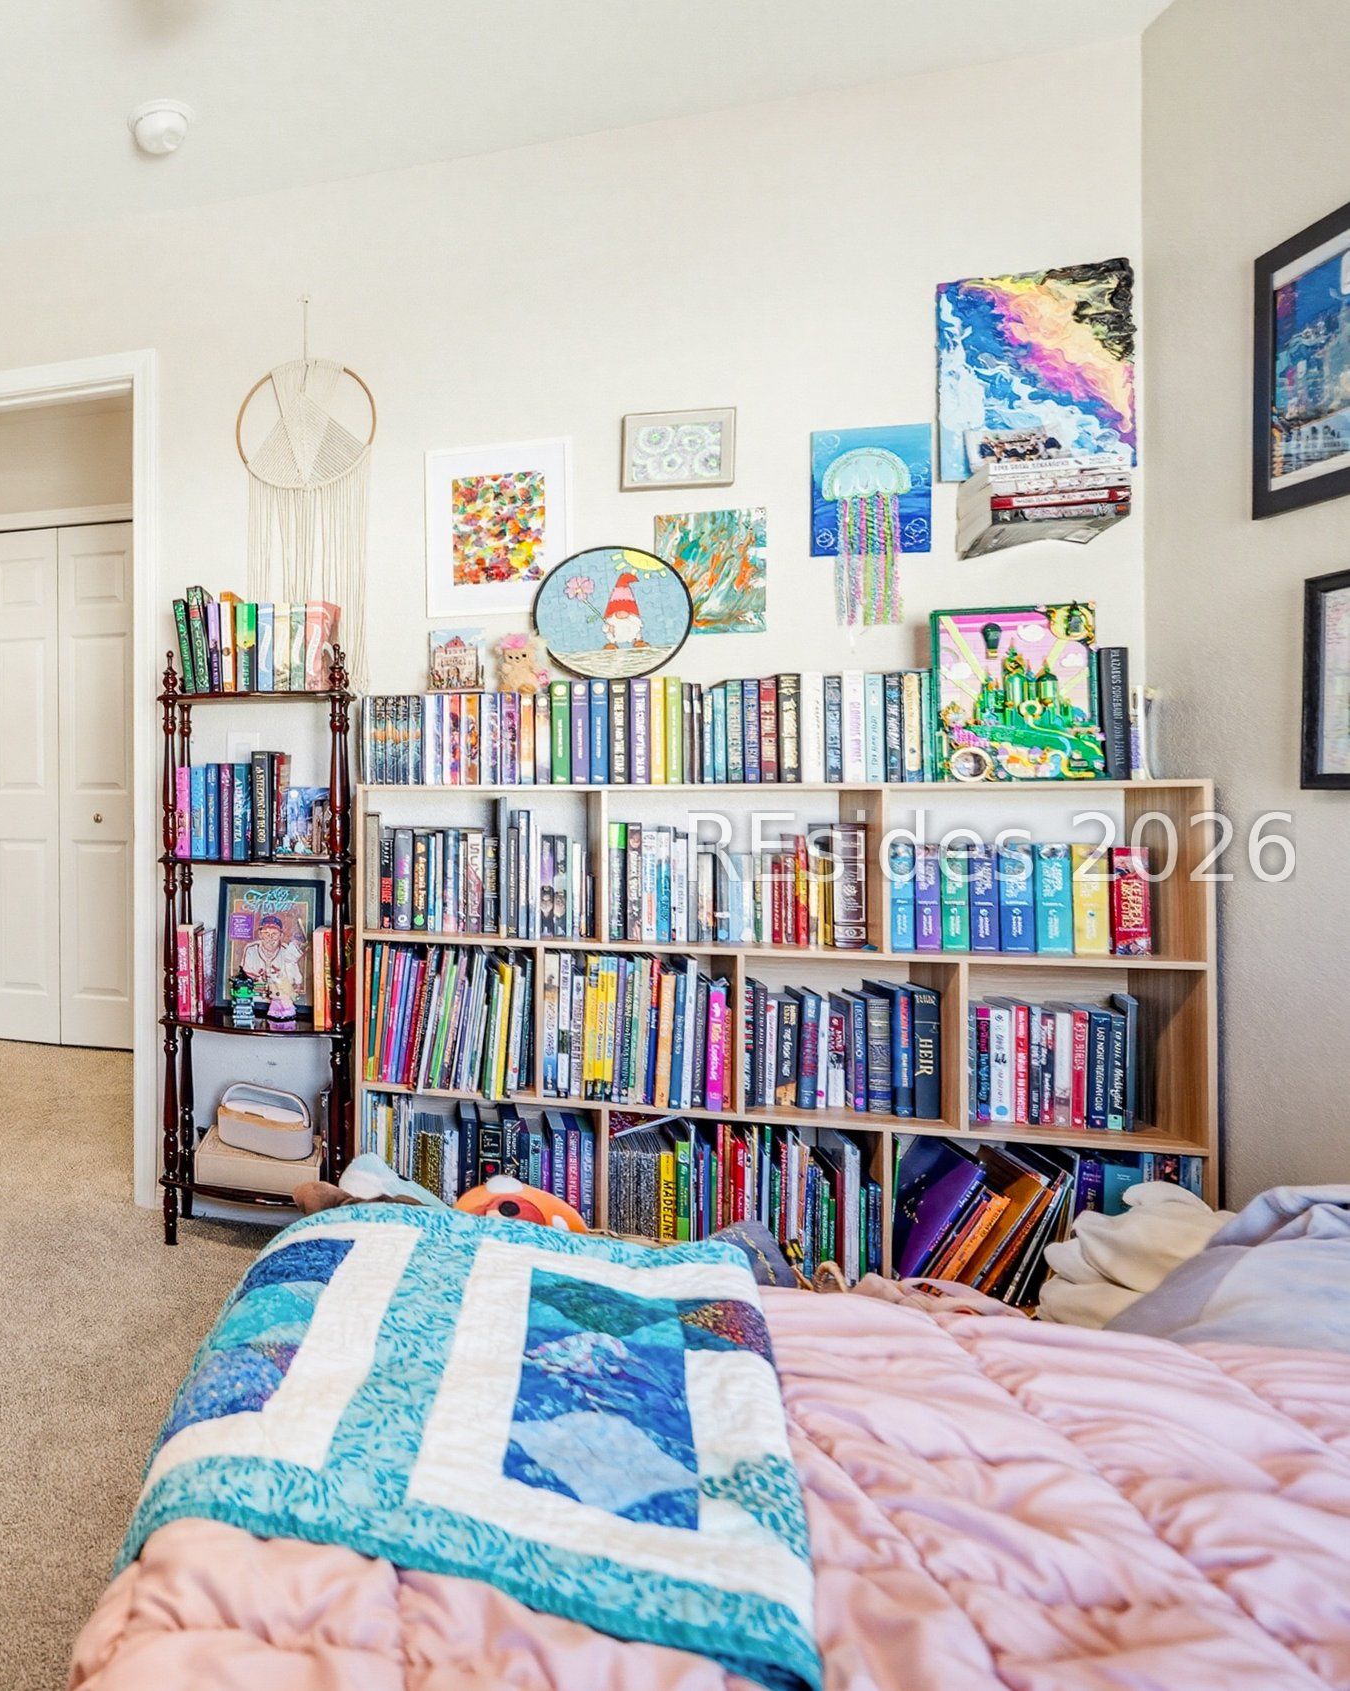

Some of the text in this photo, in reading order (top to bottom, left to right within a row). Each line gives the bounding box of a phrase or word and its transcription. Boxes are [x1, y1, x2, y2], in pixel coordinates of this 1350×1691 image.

[614, 697, 624, 710] THE
[915, 1034, 933, 1076] HEIR
[663, 1179, 674, 1239] MADELINE
